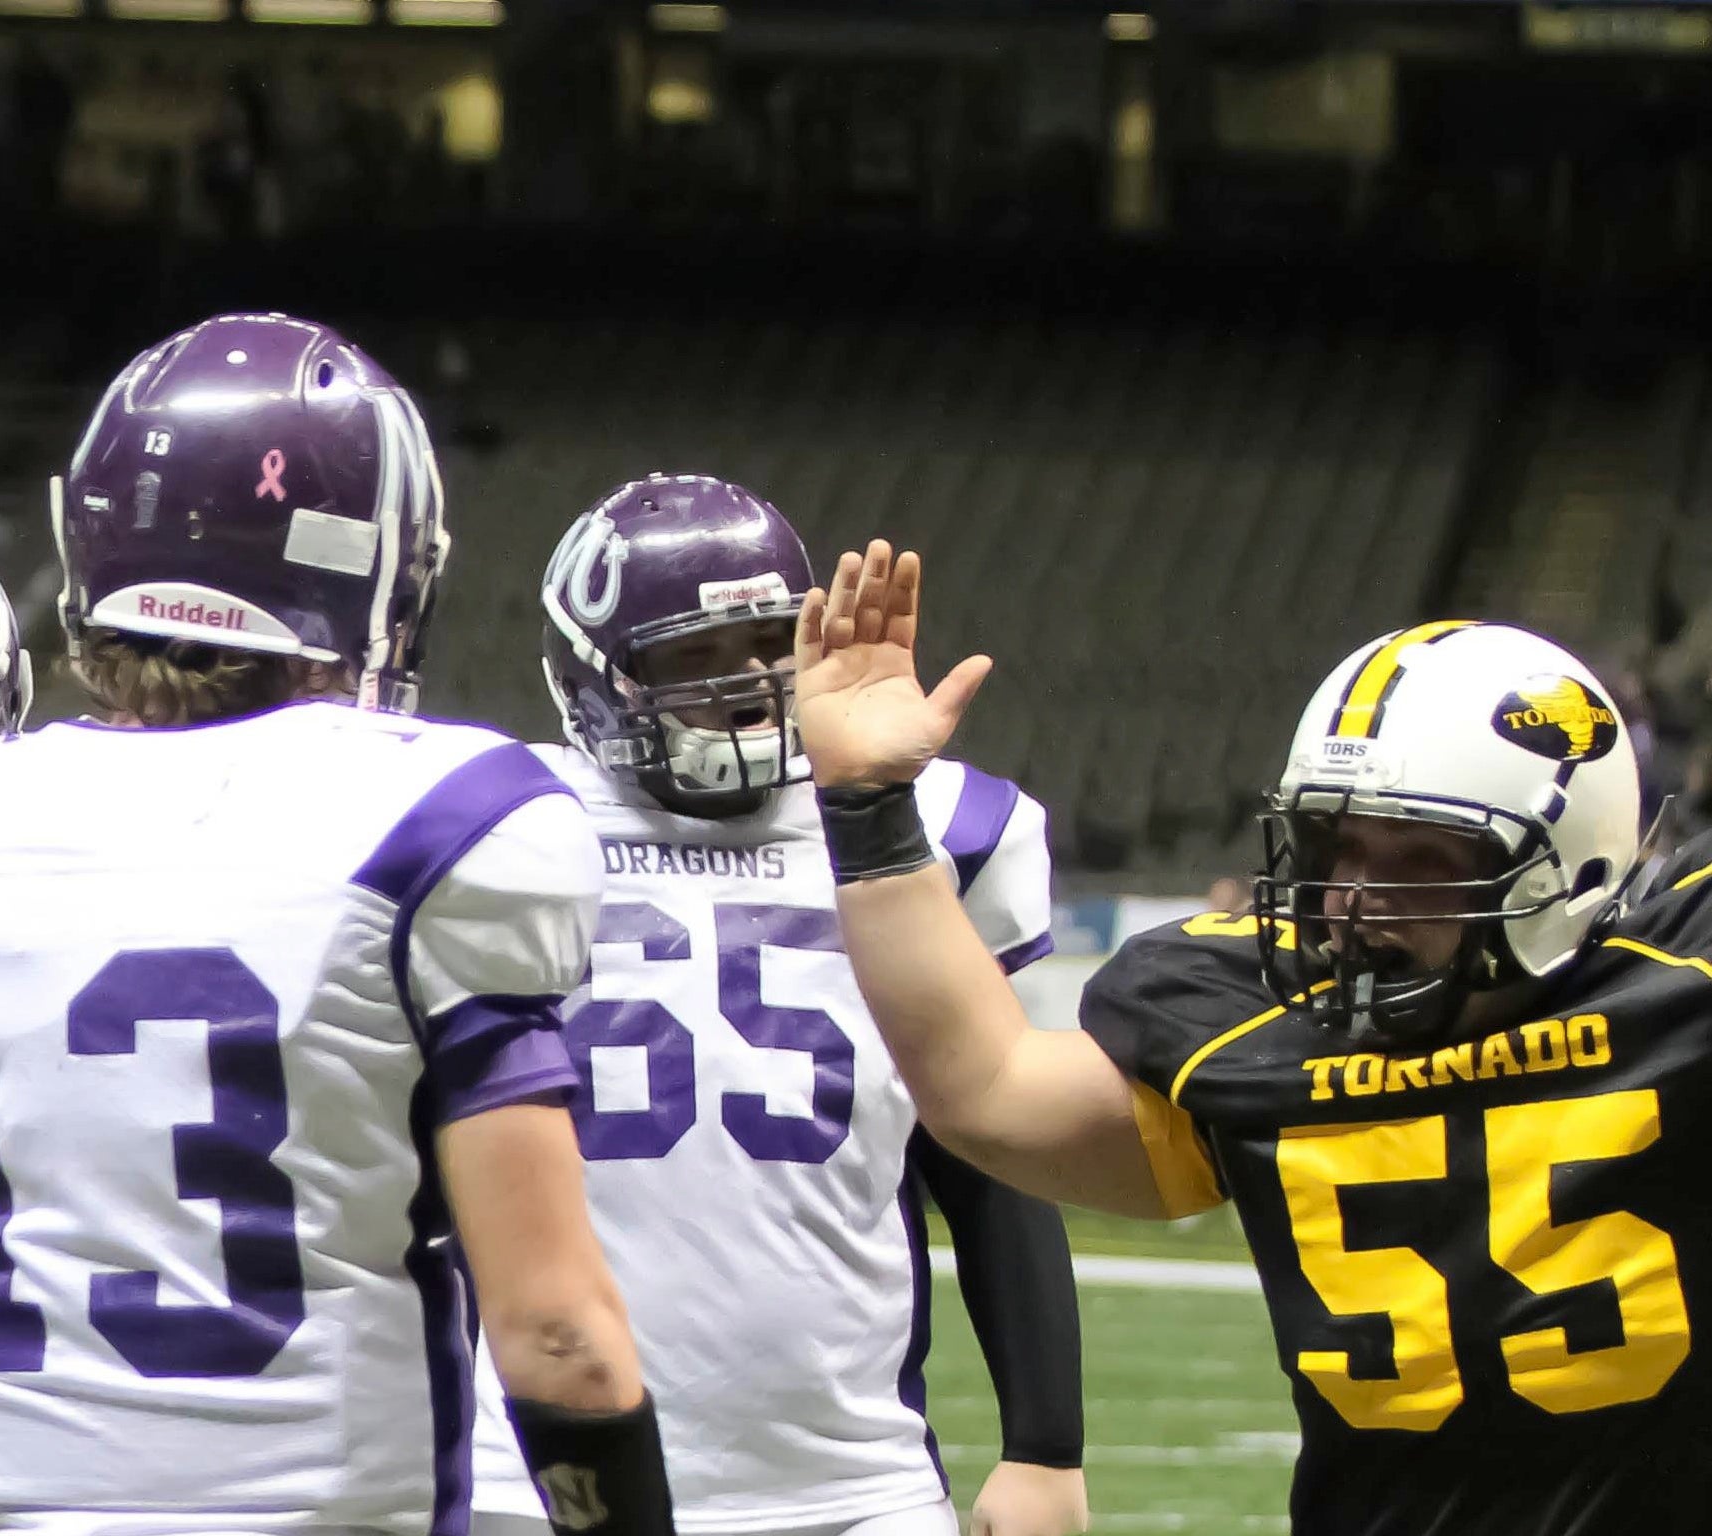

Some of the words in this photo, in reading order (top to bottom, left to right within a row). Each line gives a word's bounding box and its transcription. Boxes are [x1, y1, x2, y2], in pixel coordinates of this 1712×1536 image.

[144, 430, 172, 456] 13
[139, 594, 248, 632] Riddell
[1322, 742, 1369, 757] TORS
[598, 838, 786, 880] DRAGONS
[565, 902, 855, 1165] 65
[1301, 1012, 1613, 1101] TORNADO
[1275, 1088, 1692, 1432] 55
